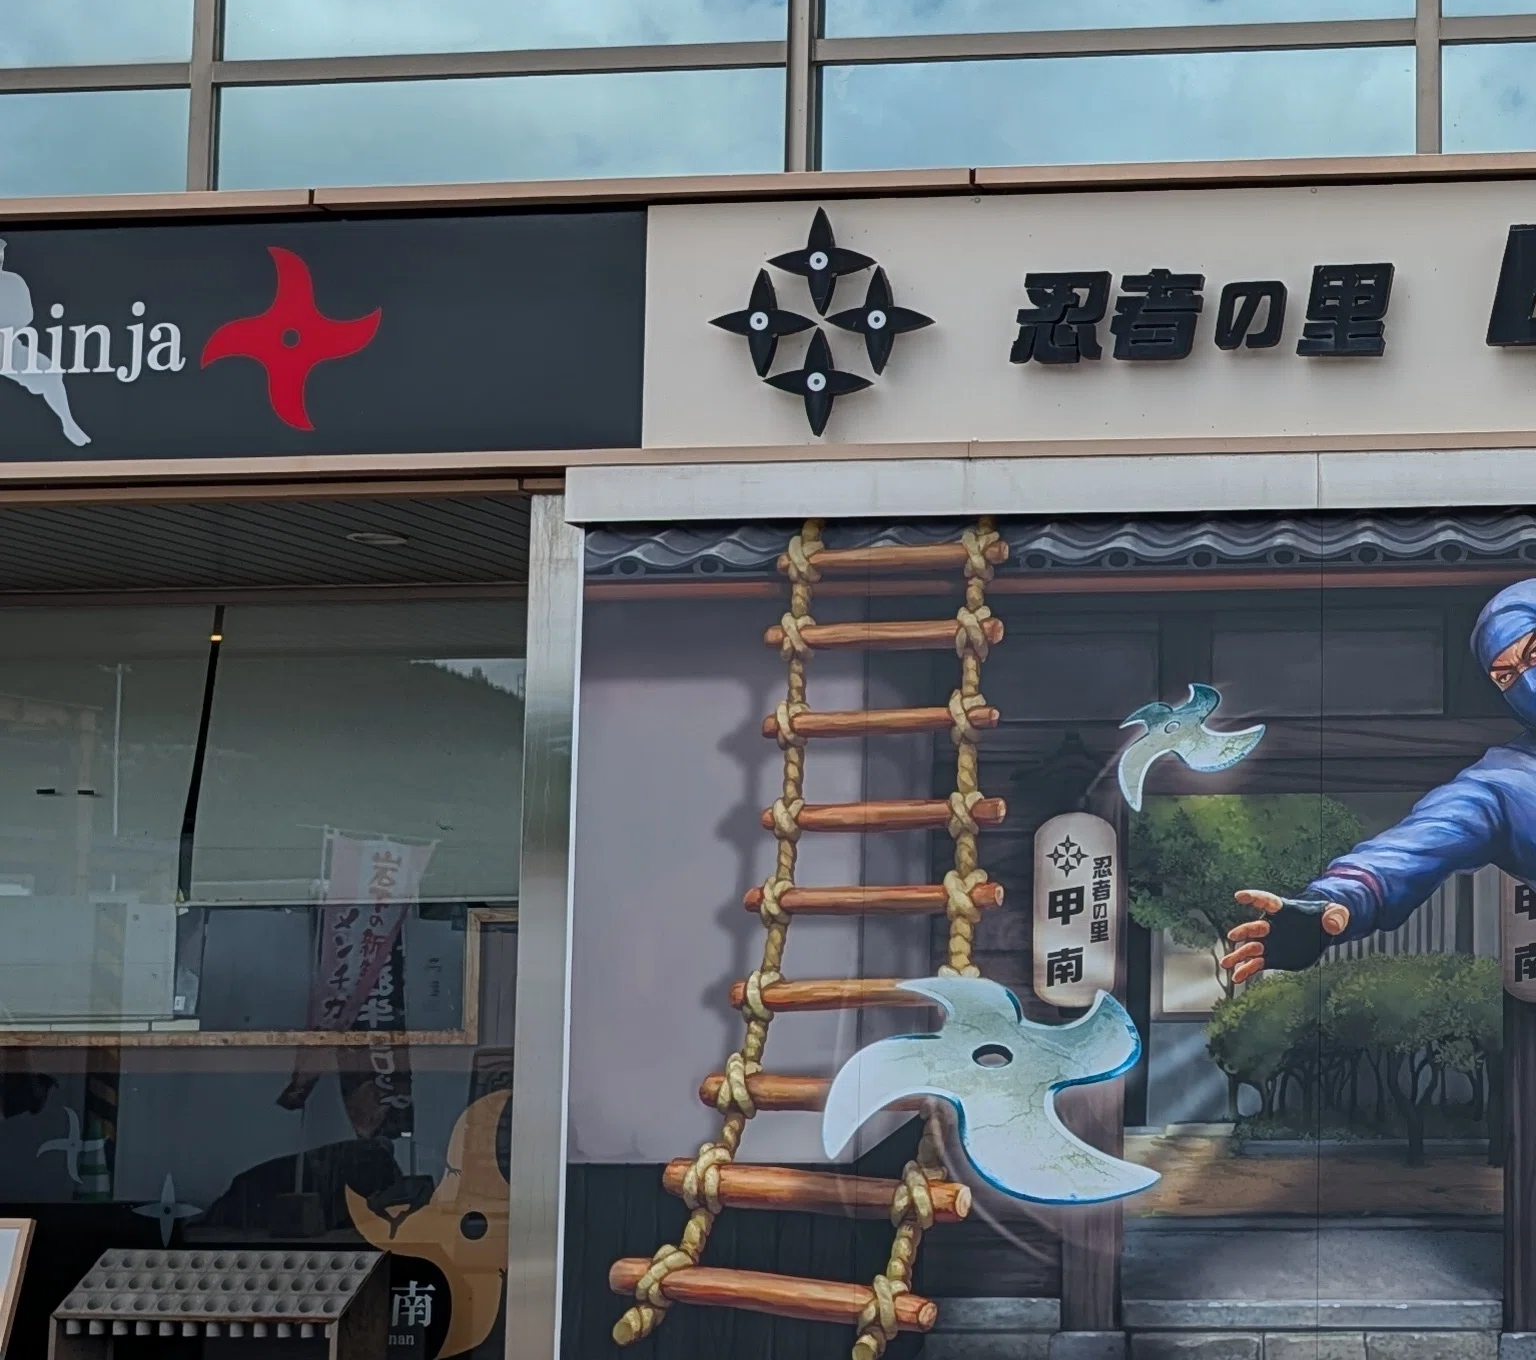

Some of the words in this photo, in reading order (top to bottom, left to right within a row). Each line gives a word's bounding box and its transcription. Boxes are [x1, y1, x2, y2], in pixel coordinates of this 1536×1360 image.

[0, 301, 186, 382] ninja
[1010, 262, 1396, 364] 忍者の里
[1046, 885, 1085, 988] 甲南
[1090, 855, 1113, 944] 忍者の里
[391, 1280, 436, 1328] 南
